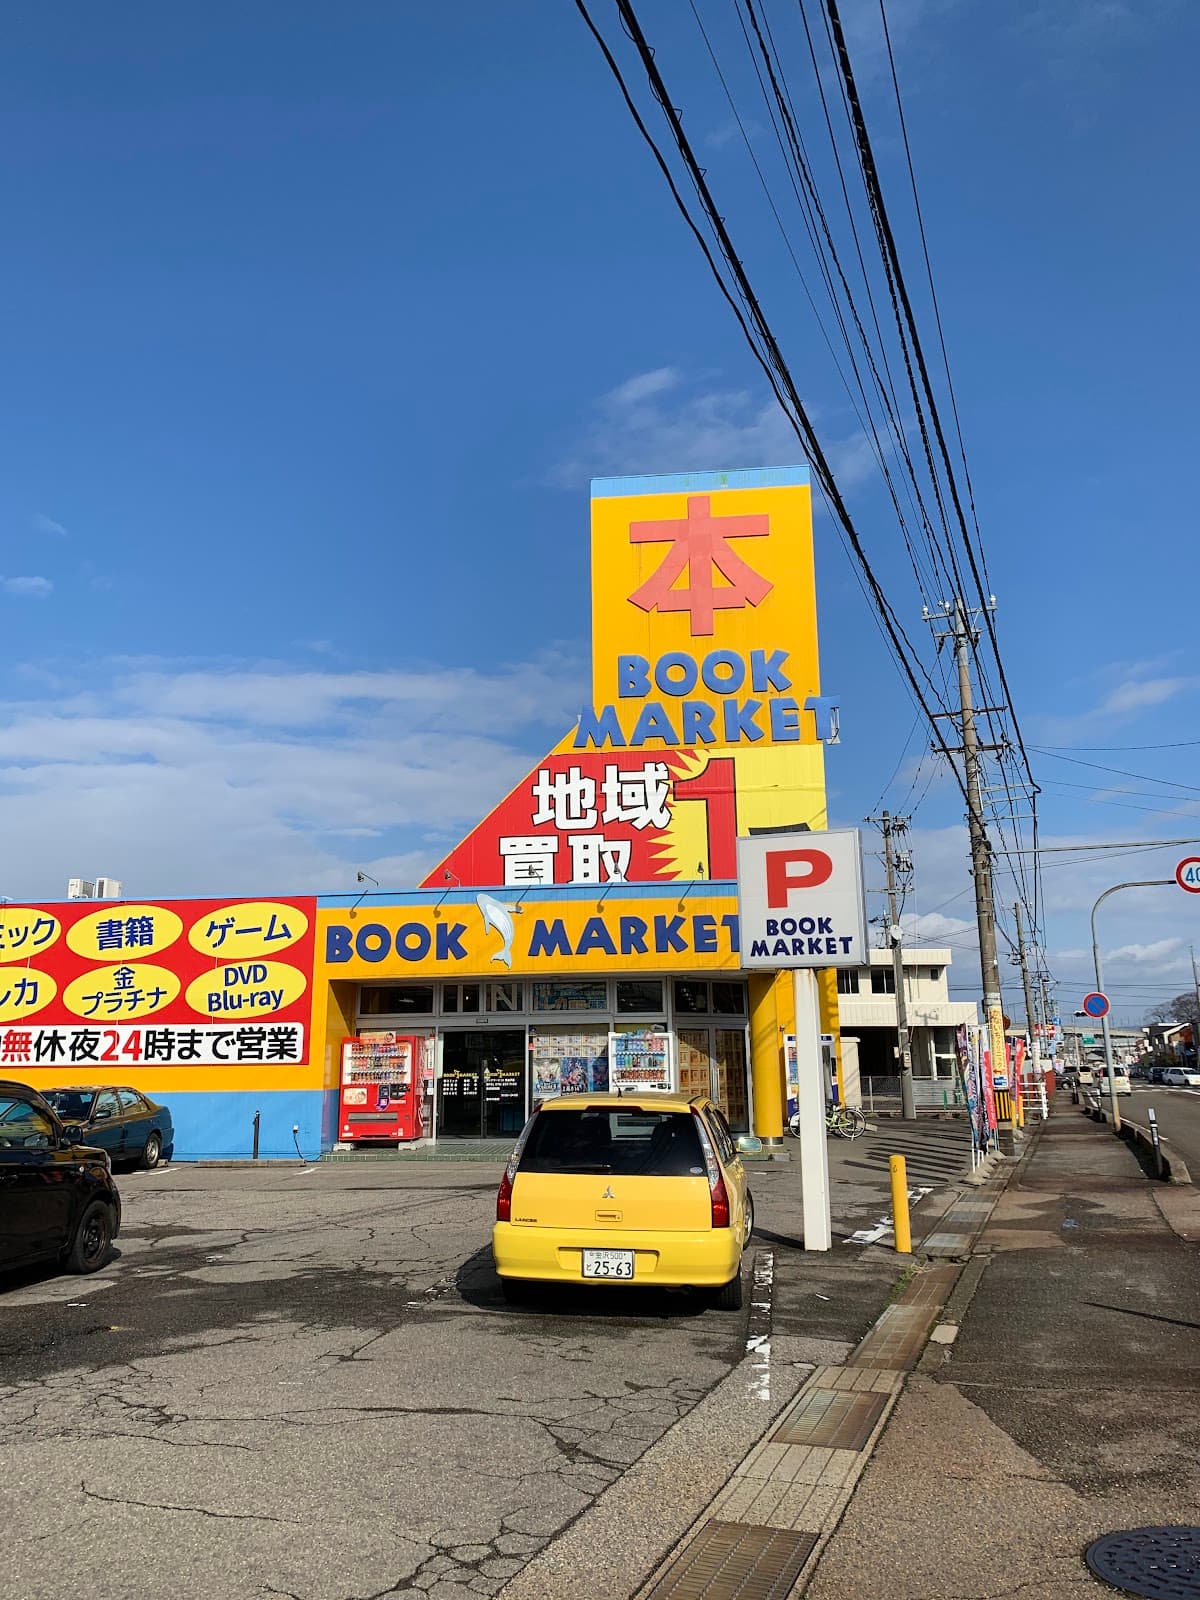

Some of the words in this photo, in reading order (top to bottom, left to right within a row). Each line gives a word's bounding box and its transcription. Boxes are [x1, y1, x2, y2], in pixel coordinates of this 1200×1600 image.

[627, 496, 774, 636] 本
[618, 649, 792, 698] BOOK
[573, 695, 840, 748] MARKET
[532, 762, 673, 831] 地域
[499, 834, 632, 886] 買取
[766, 849, 833, 909] P
[96, 916, 154, 950] 書籍
[206, 914, 292, 948] ゲーム
[326, 922, 468, 963] BOOK
[528, 913, 740, 957] MARKET
[766, 917, 833, 936] BOOK
[750, 937, 853, 957] MARKET
[113, 967, 135, 990] 金
[224, 964, 267, 986] DVD
[82, 987, 167, 1015] プラチナ
[208, 989, 284, 1012] Blu-ray
[0, 1026, 299, 1063] 無休夜24時まで営業
[594, 1261, 631, 1275] 25-63
